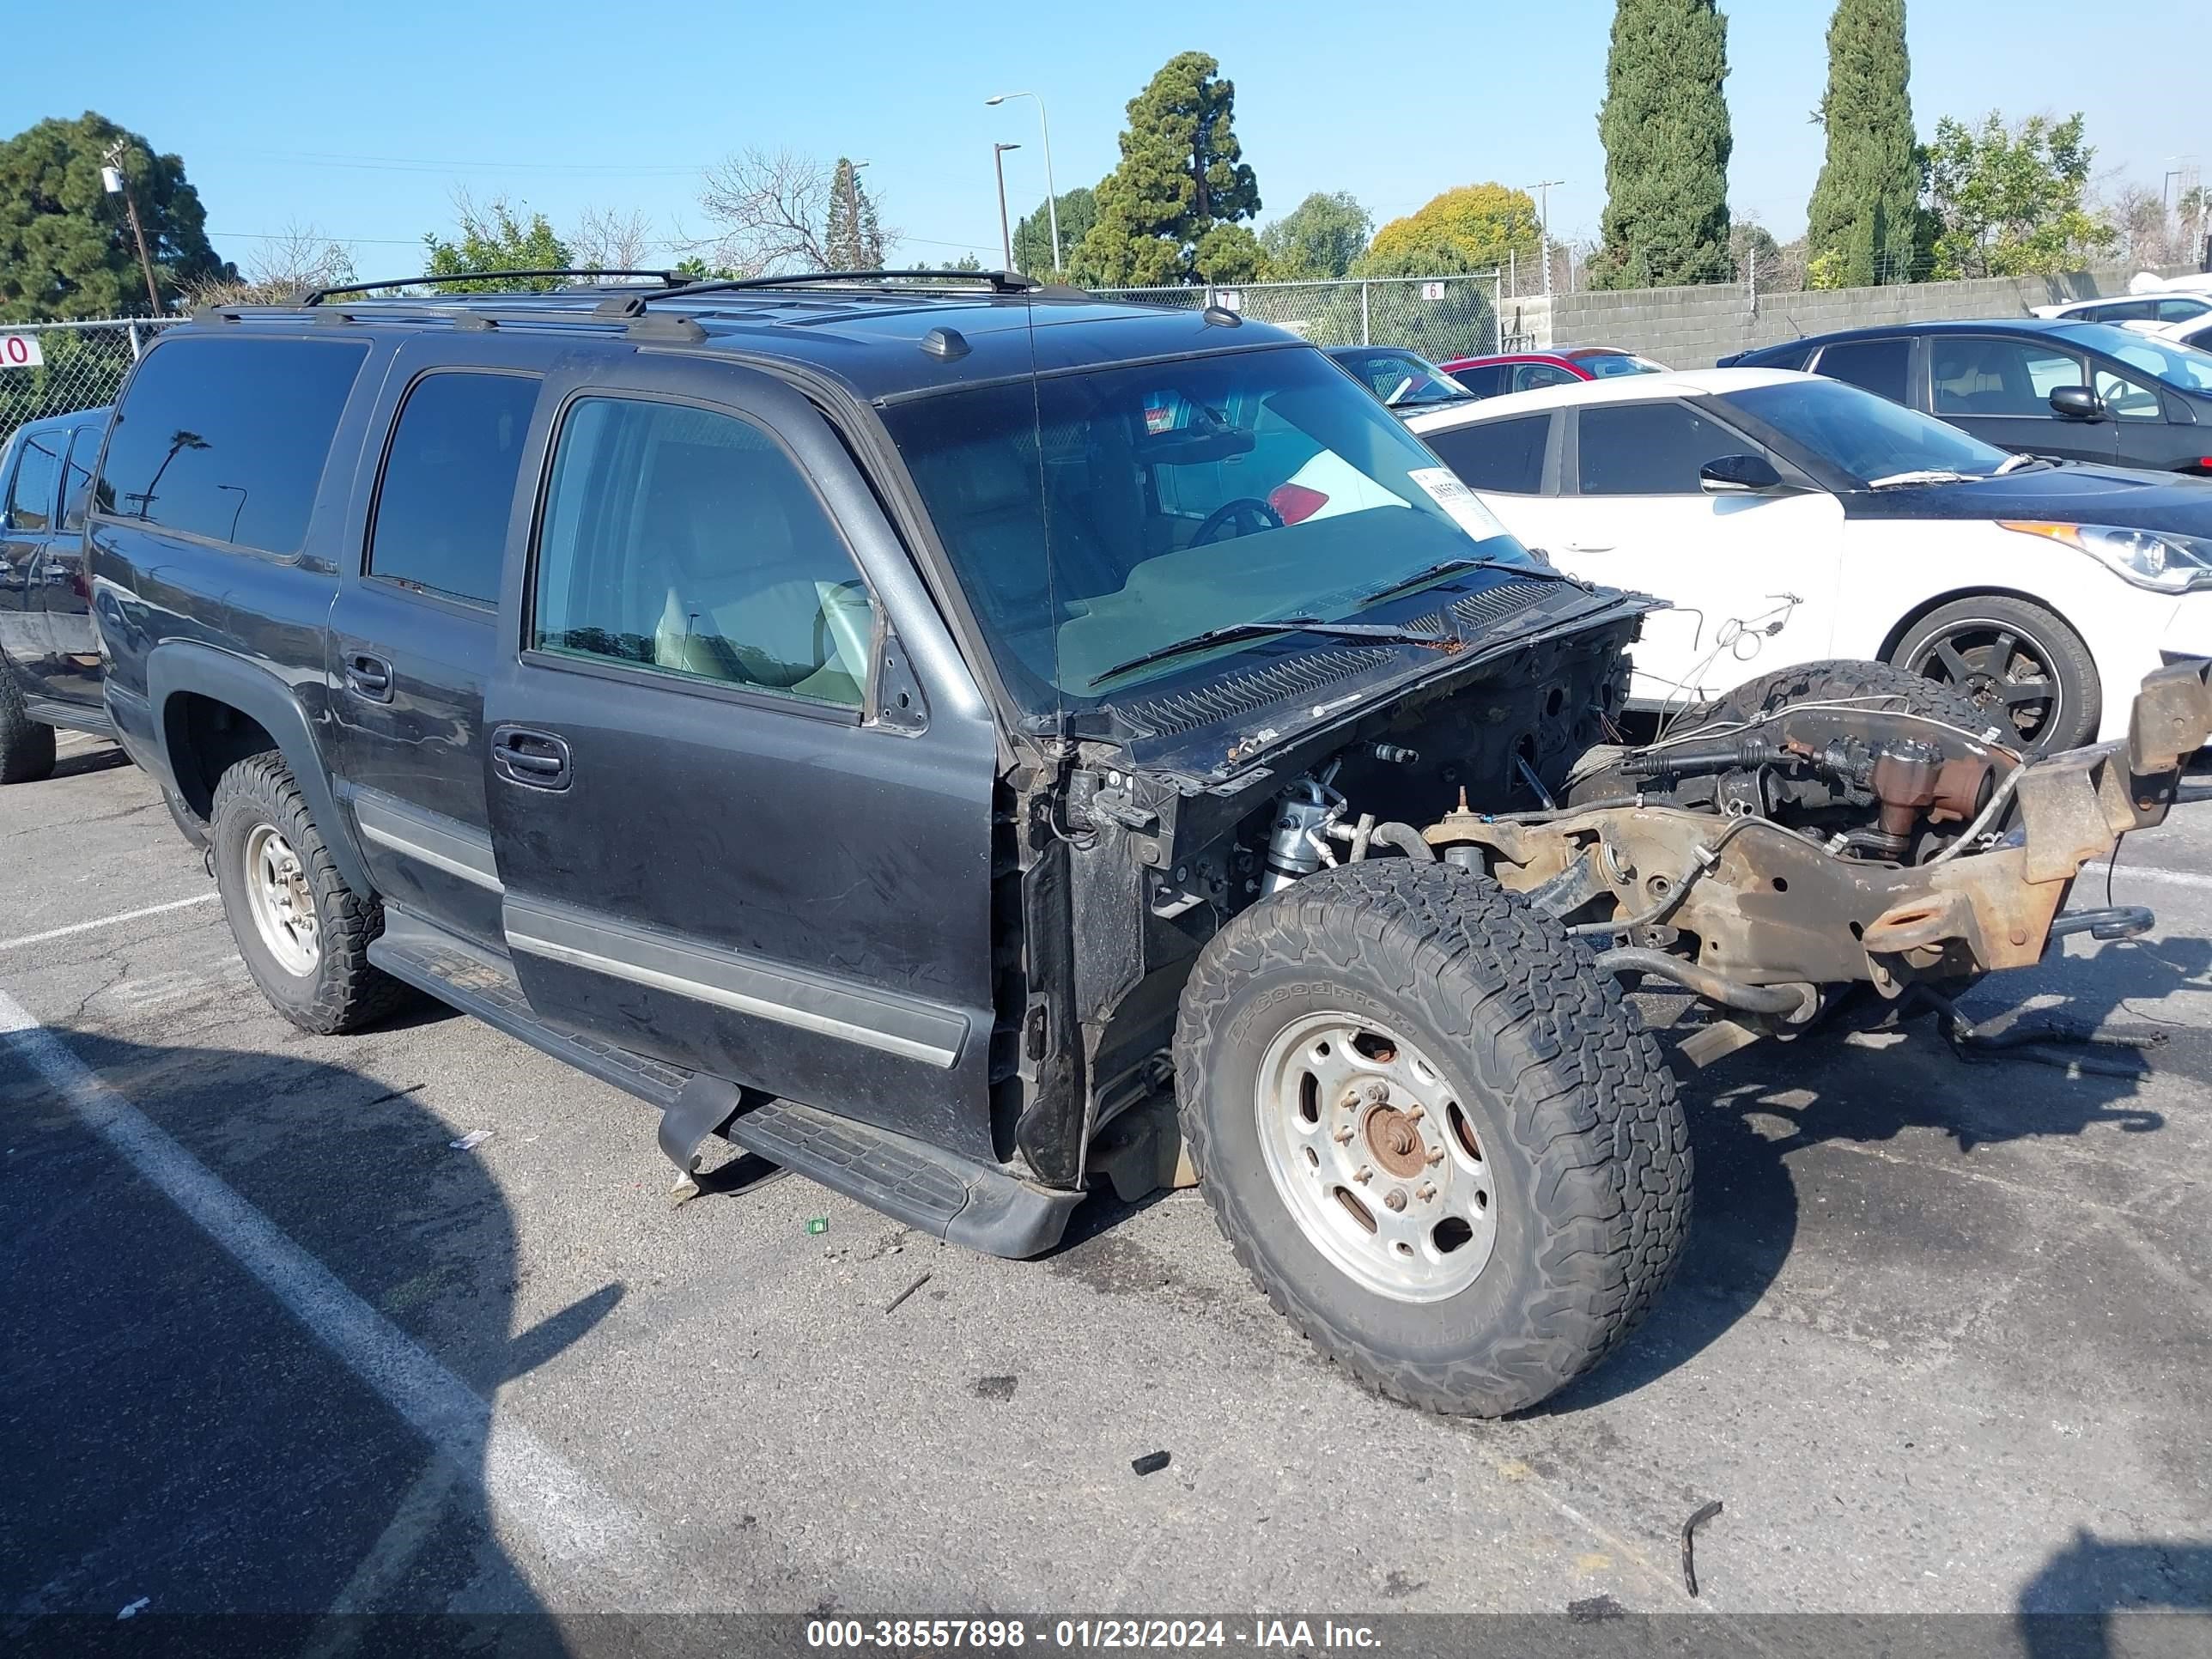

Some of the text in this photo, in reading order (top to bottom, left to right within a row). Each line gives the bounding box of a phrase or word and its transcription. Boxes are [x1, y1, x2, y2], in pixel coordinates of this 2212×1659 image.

[1431, 283, 1437, 298] 6
[1222, 292, 1230, 310] 7
[1226, 980, 1418, 1049] BFGoodrich
